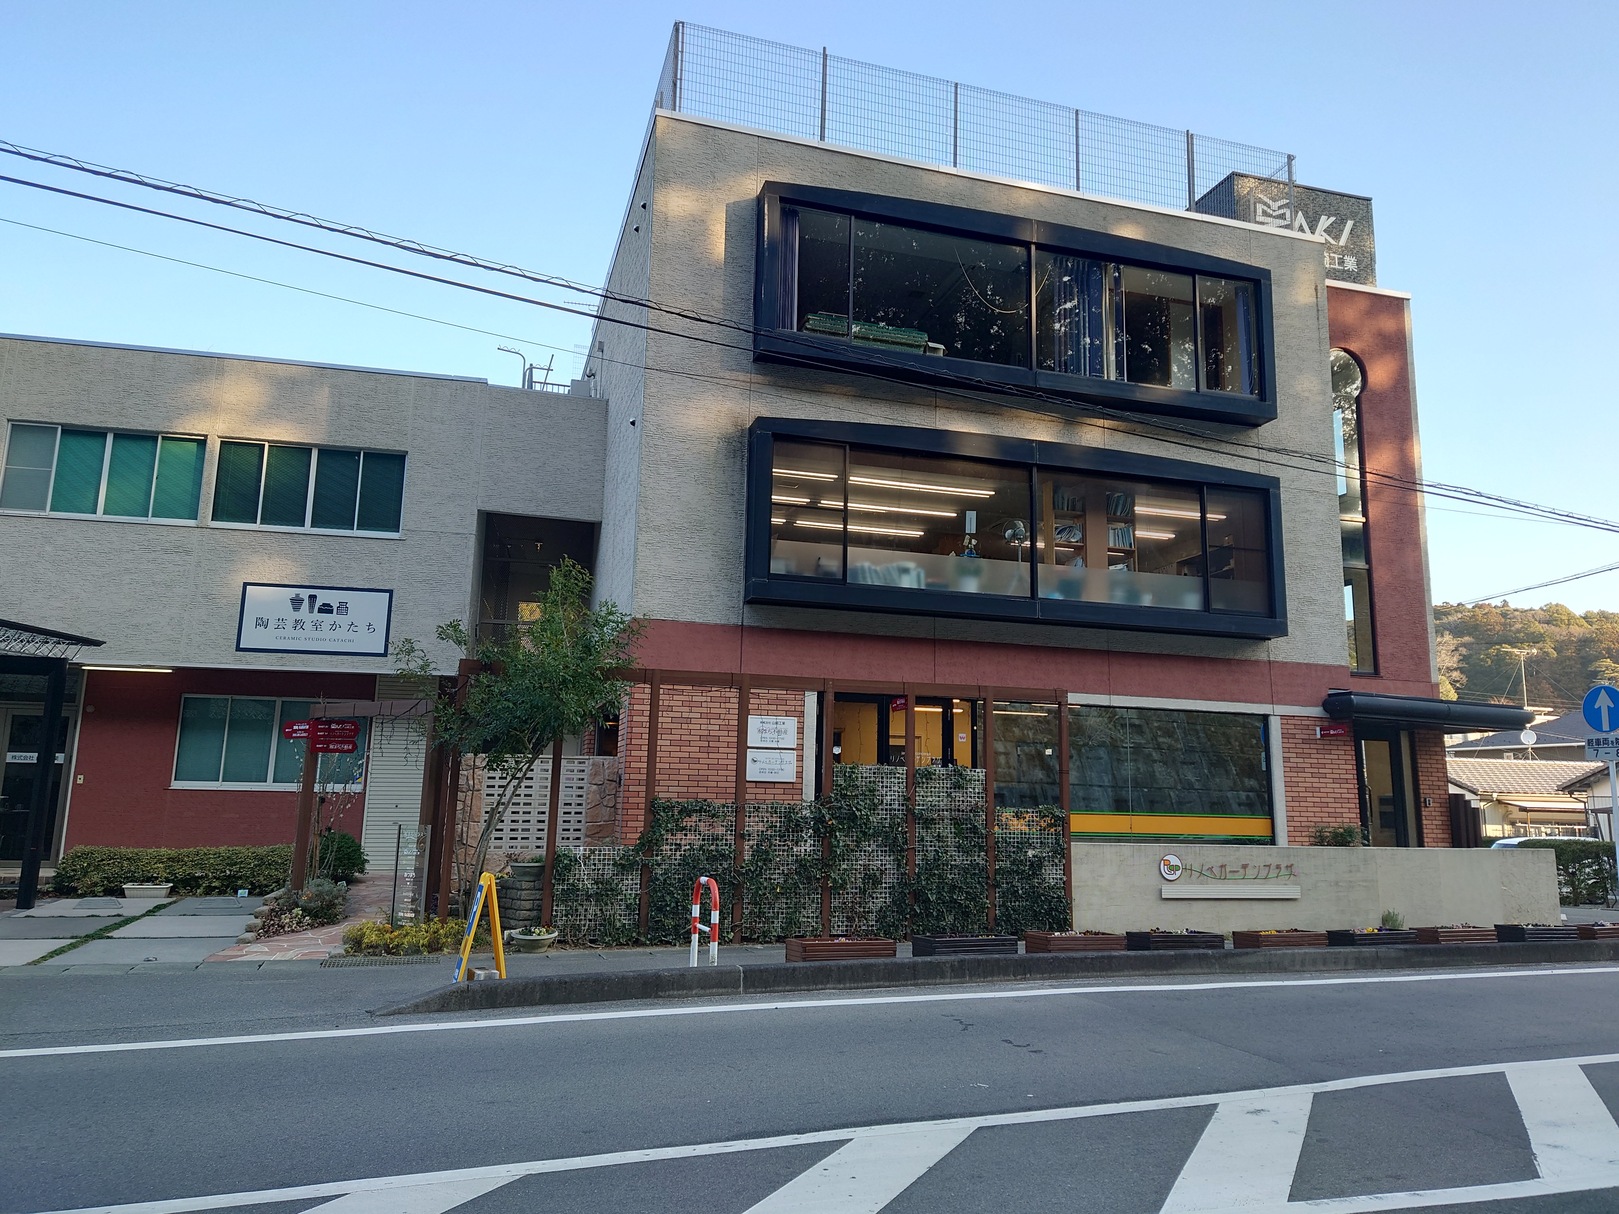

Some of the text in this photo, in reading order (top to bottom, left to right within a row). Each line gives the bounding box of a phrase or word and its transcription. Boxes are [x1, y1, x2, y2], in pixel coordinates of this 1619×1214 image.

[254, 616, 377, 634] 陶芸教室かたち
